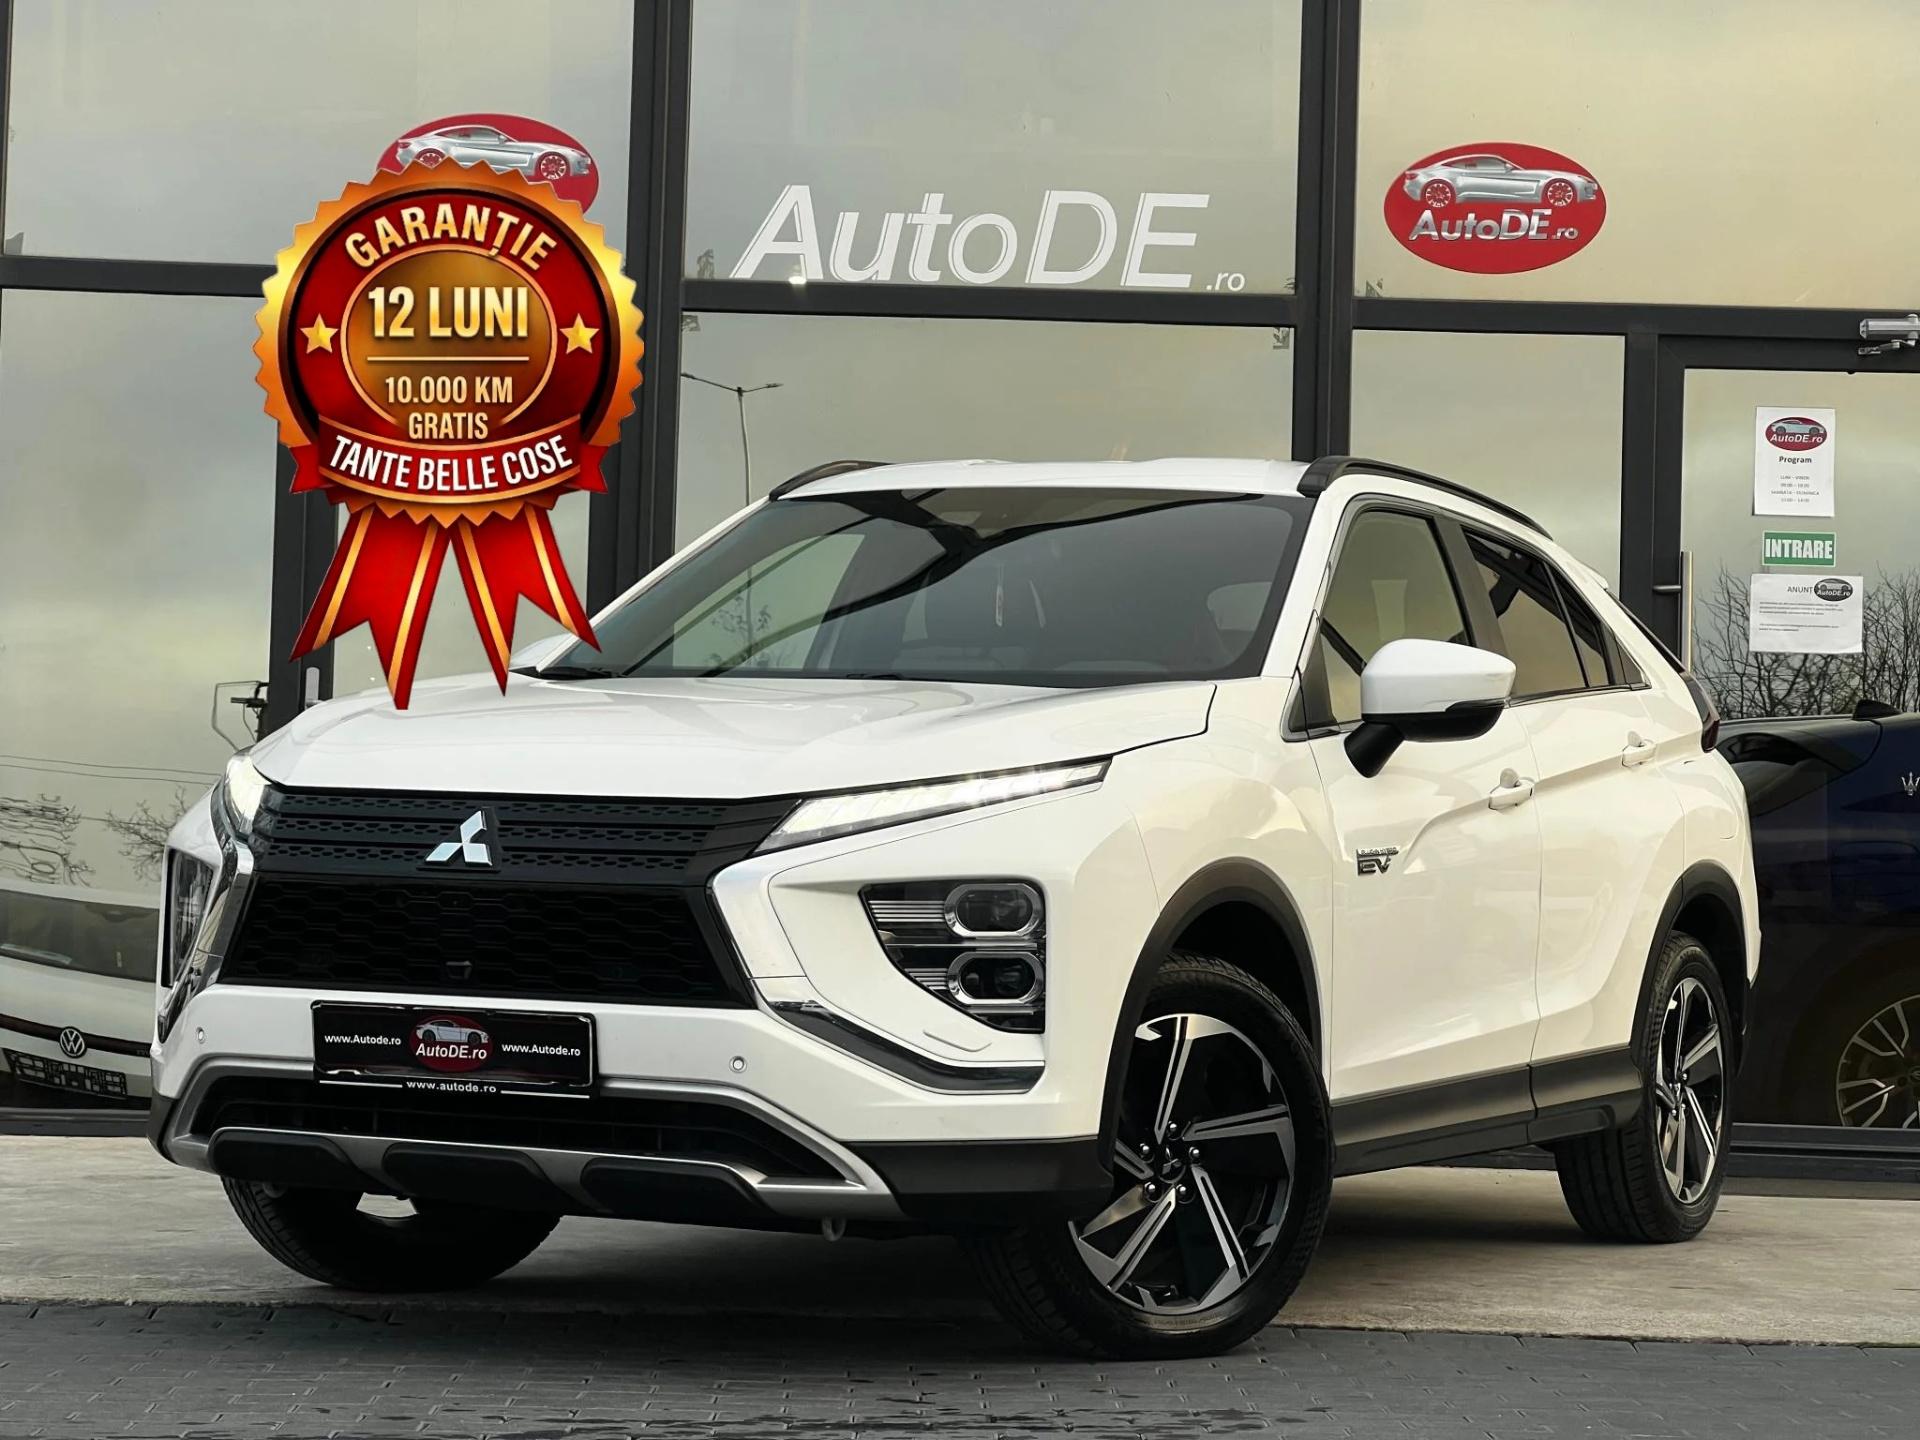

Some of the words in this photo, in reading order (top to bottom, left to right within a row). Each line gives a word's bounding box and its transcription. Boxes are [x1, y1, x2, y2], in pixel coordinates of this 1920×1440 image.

[1769, 433, 1824, 444] AutoDE.ro
[1779, 456, 1812, 465] Program
[1764, 538, 1833, 559] INTRARE
[1357, 857, 1391, 876] EV
[324, 1034, 402, 1046] www.Autode.ro
[416, 1042, 488, 1060] AutoDE.ro
[501, 1043, 581, 1057] www.Autode.ro
[406, 1079, 497, 1094] www.autode.ro
